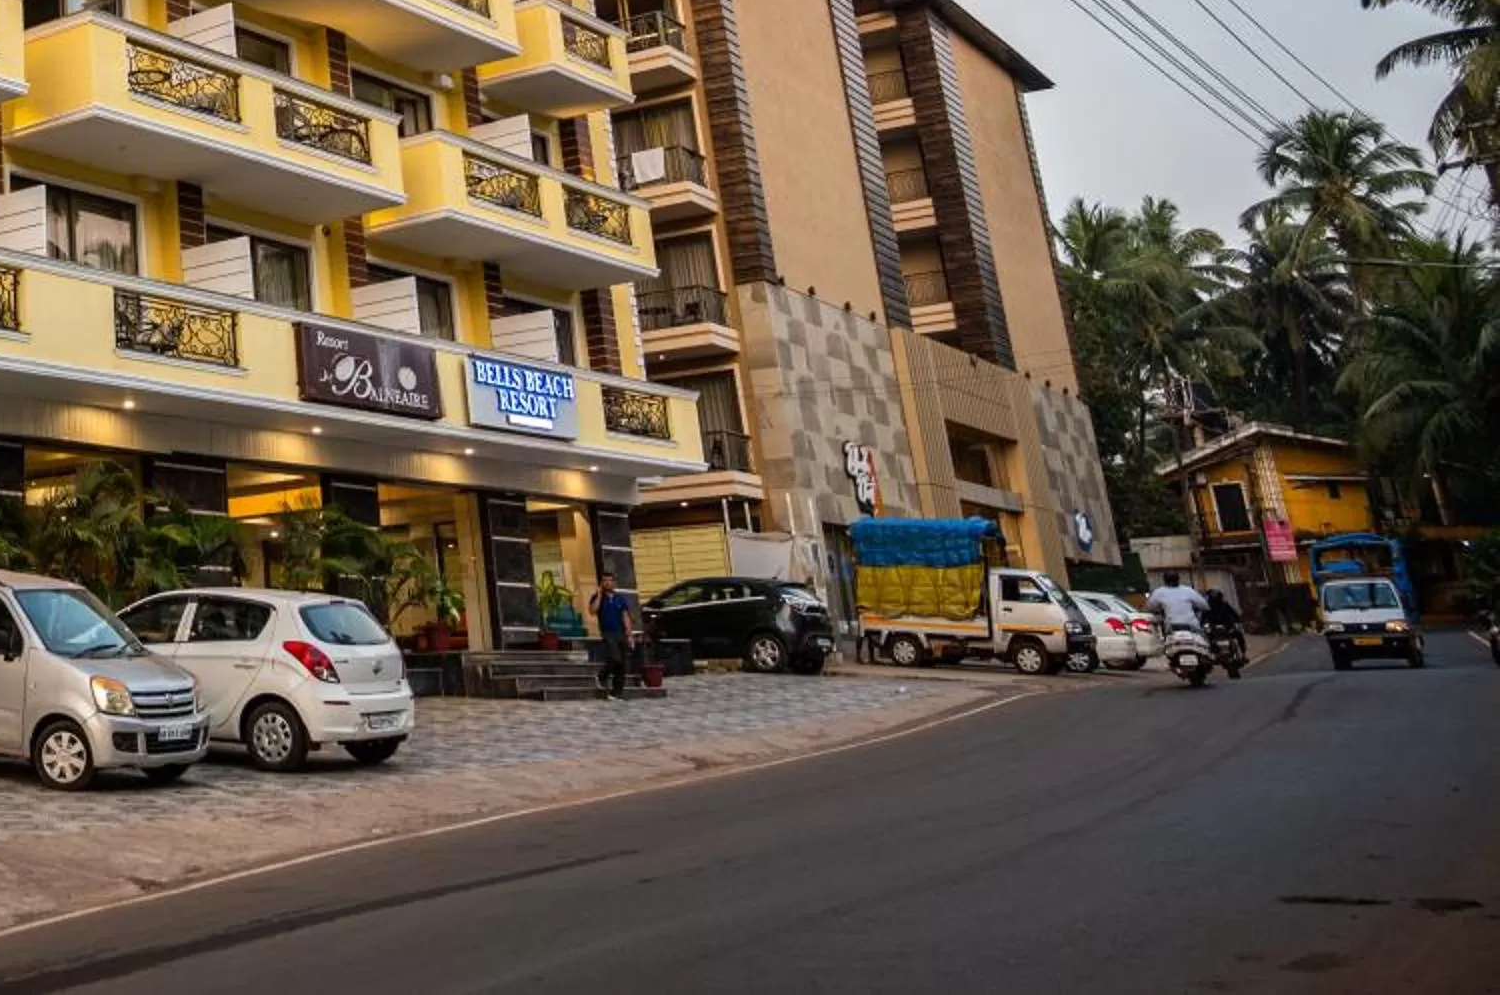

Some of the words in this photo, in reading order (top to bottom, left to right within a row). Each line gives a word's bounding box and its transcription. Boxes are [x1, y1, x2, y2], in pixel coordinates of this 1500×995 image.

[316, 330, 349, 351] Resort
[475, 361, 521, 390] BELLS
[523, 370, 574, 399] BEACH
[498, 388, 557, 419] RESORT
